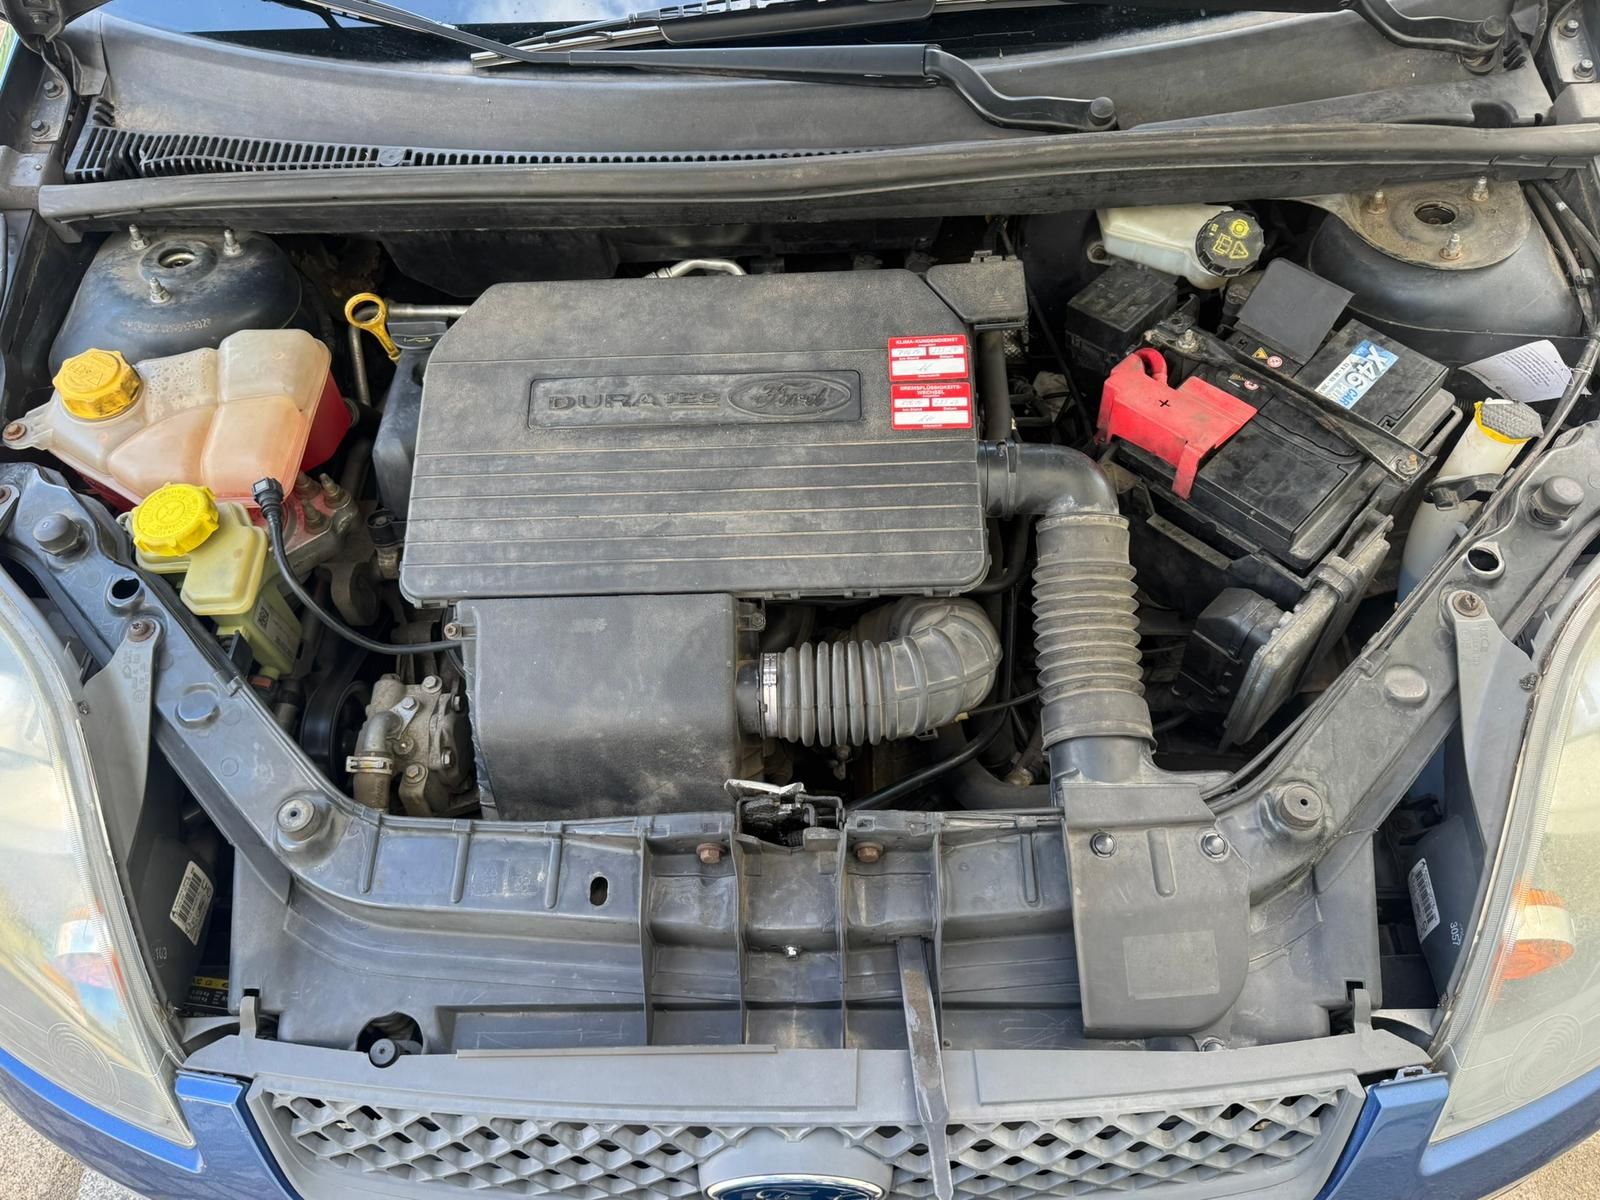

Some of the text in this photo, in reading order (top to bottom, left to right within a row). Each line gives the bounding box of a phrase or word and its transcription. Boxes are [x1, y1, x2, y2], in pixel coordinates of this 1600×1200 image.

[1345, 345, 1387, 388] X46
[549, 382, 827, 409] DURATEC Ford
[1339, 388, 1359, 407] CAR
